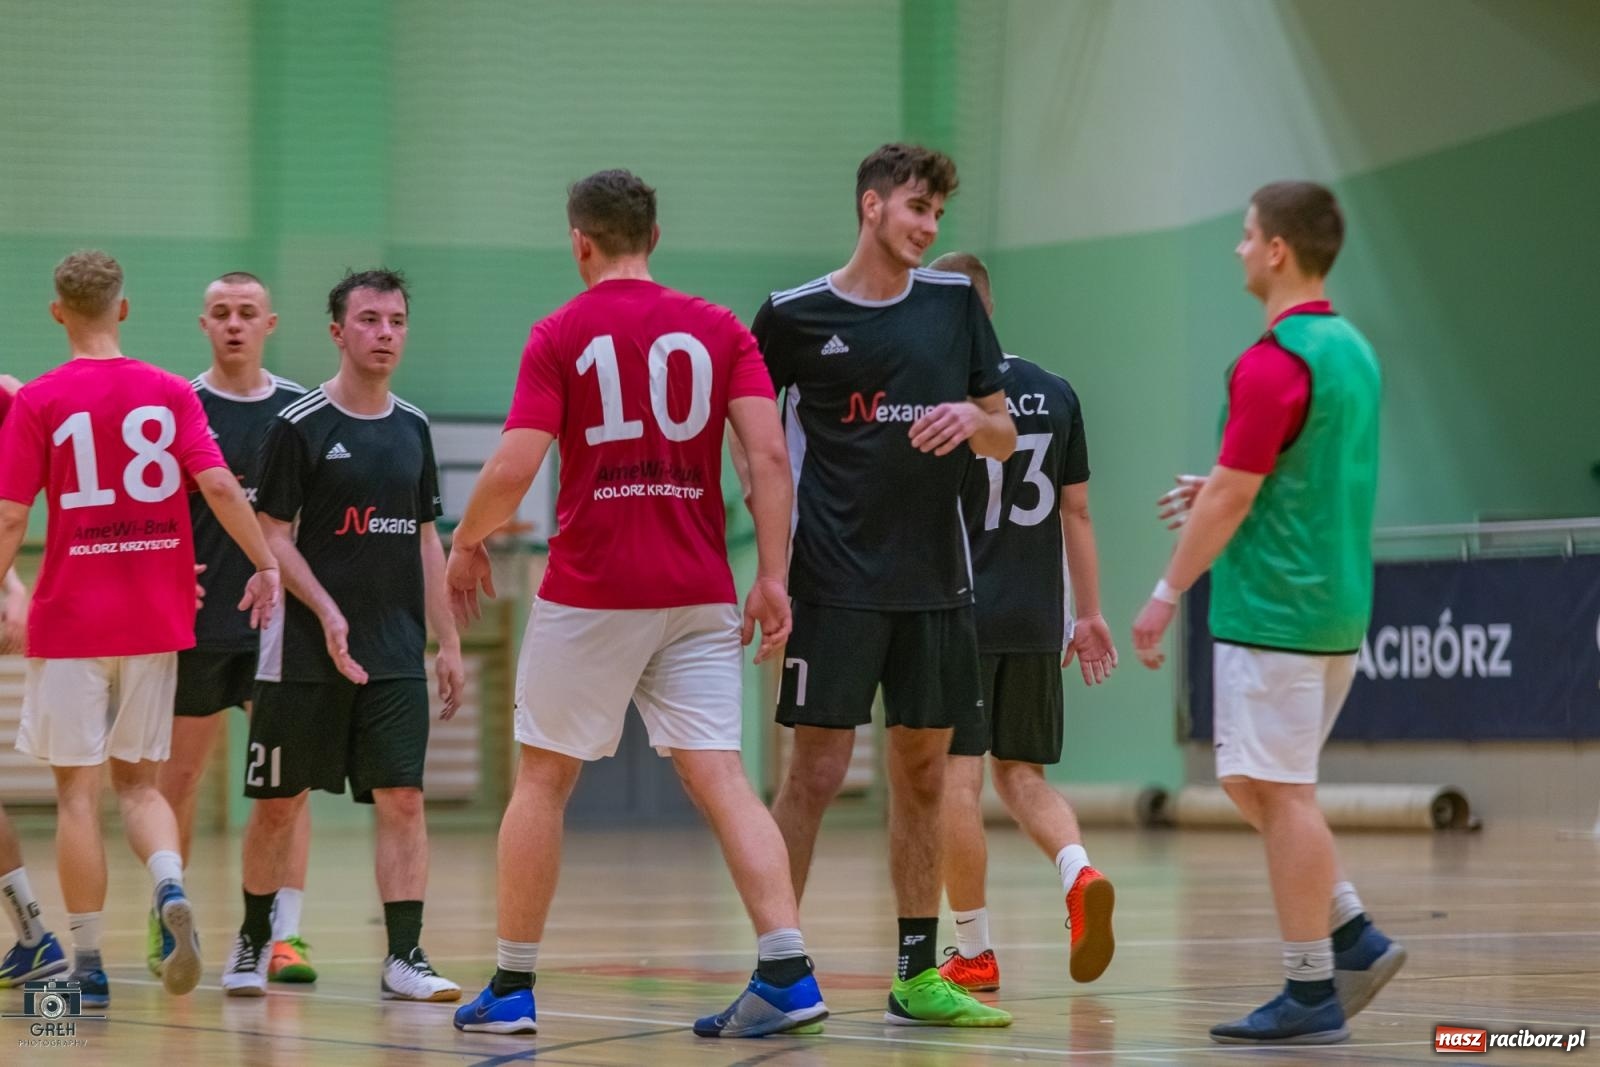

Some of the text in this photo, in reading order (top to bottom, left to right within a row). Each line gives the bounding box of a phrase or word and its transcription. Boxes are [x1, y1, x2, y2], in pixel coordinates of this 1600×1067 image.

[575, 331, 713, 446] 10
[52, 405, 181, 510] 18
[593, 484, 645, 500] KOLORZ
[334, 506, 417, 535] Nexans
[69, 543, 118, 556] KOLORZ
[785, 657, 808, 707] 7
[246, 742, 282, 787] 21
